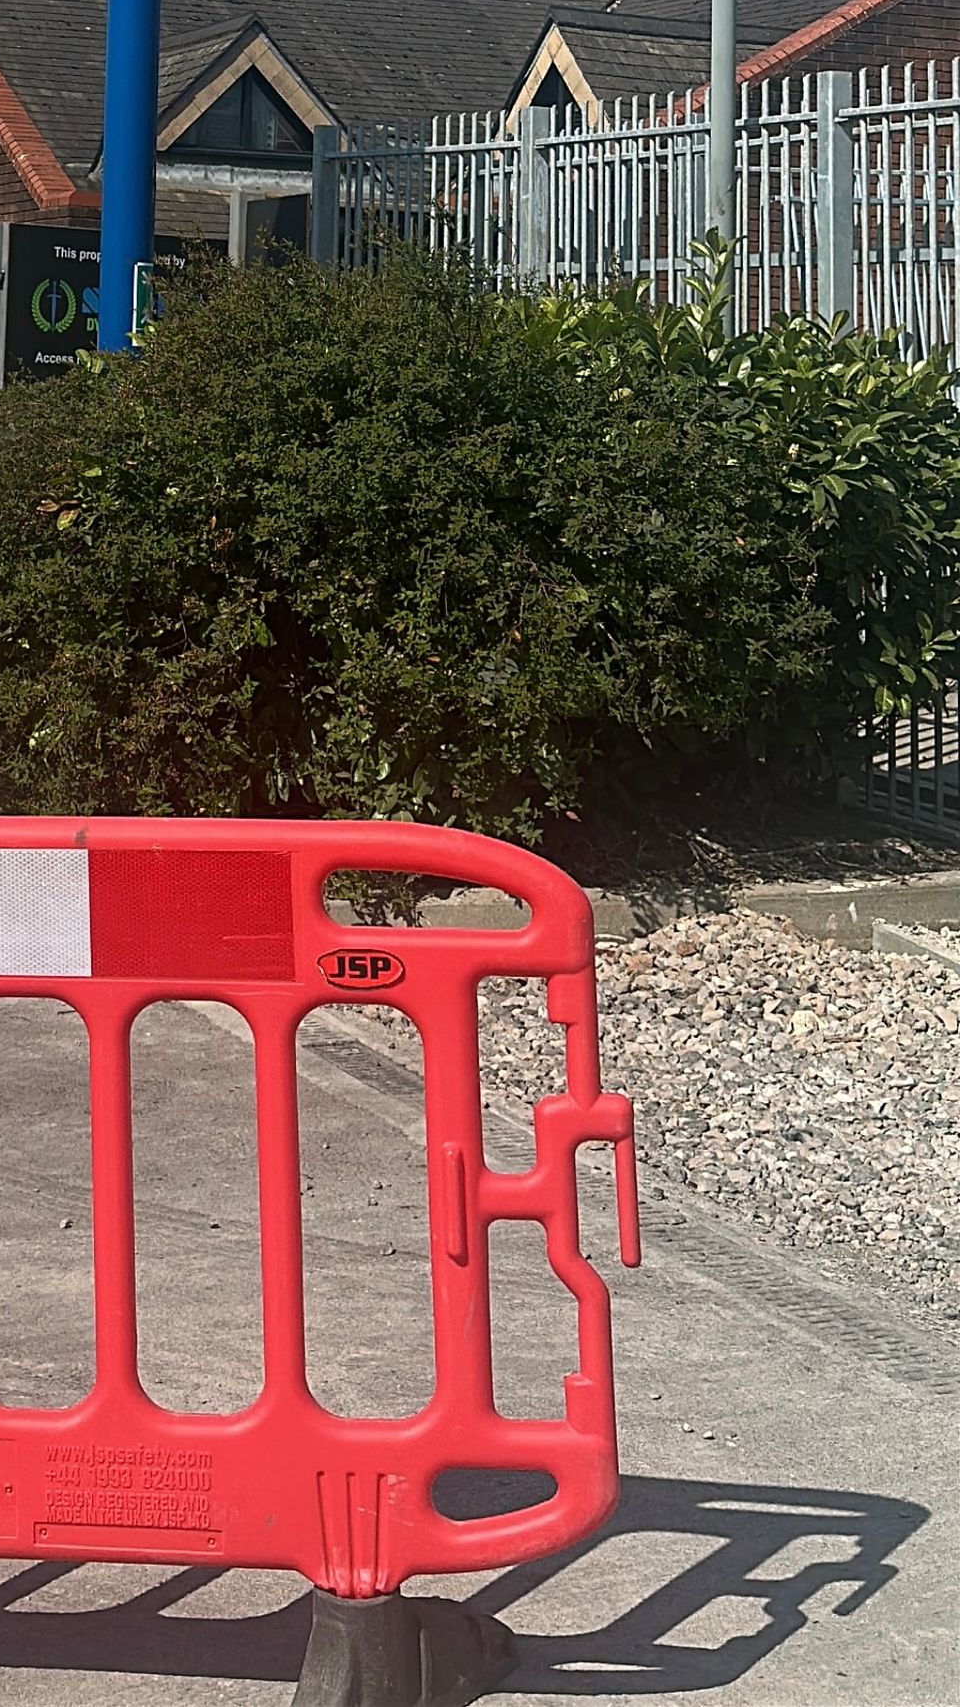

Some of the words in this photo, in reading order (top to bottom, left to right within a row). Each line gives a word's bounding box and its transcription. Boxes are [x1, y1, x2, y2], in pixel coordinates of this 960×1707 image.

[54, 246, 77, 259] This
[79, 250, 102, 262] prop
[173, 255, 186, 269] by
[35, 351, 74, 365] Access
[329, 956, 391, 979] JSP
[46, 1444, 213, 1470] www.jspsafety.com
[46, 1464, 81, 1487] +44
[46, 1489, 94, 1509] DESIGN
[97, 1492, 179, 1513] REGISTERED
[182, 1496, 210, 1513] AND
[46, 1506, 82, 1524] MADE
[84, 1508, 96, 1525] IN
[99, 1509, 122, 1526] THE
[123, 1510, 143, 1527] UK
[146, 1511, 161, 1527] BY
[162, 1512, 185, 1528] JSP
